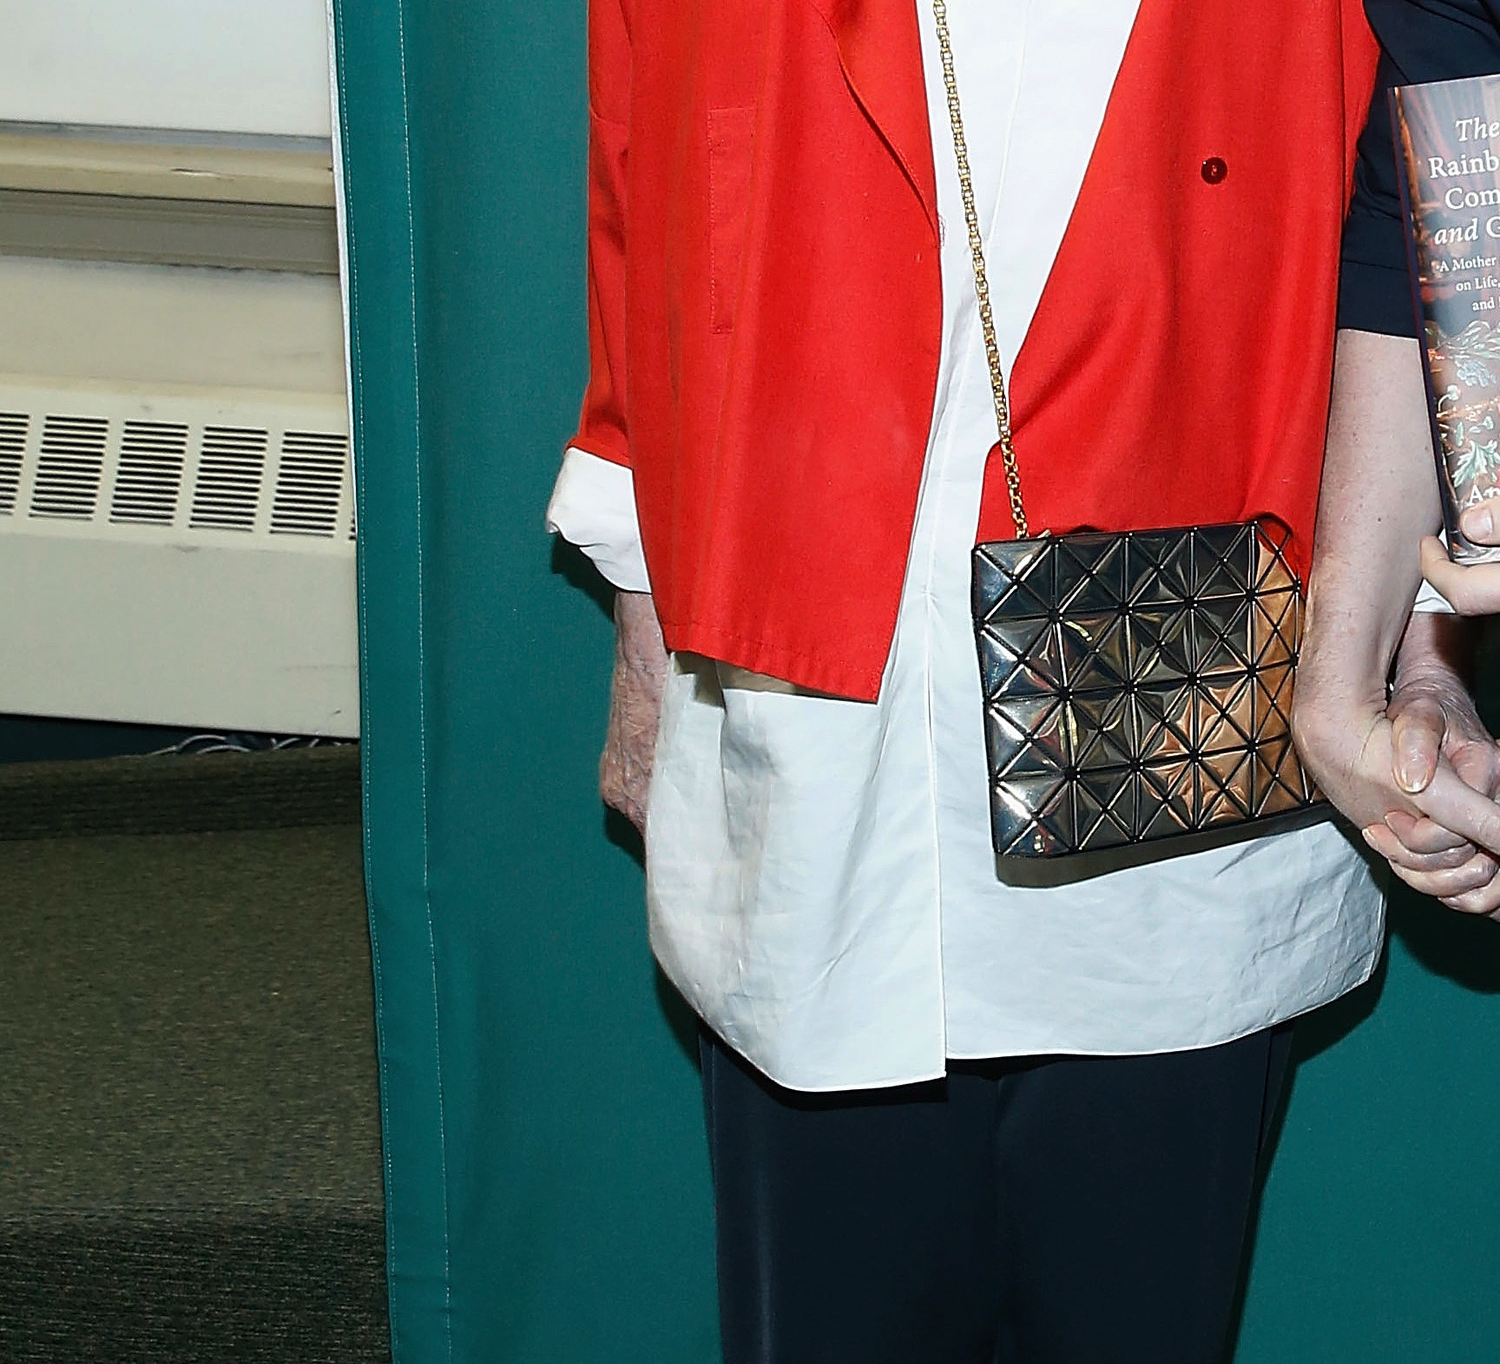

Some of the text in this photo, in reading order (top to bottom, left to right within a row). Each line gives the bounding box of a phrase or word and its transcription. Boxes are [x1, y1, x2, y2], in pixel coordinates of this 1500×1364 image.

[1455, 116, 1500, 142] The
[1434, 217, 1479, 245] and
[1440, 260, 1450, 272] A
[1452, 255, 1497, 272] Mother
[1455, 282, 1472, 292] on
[1472, 296, 1496, 311] and
